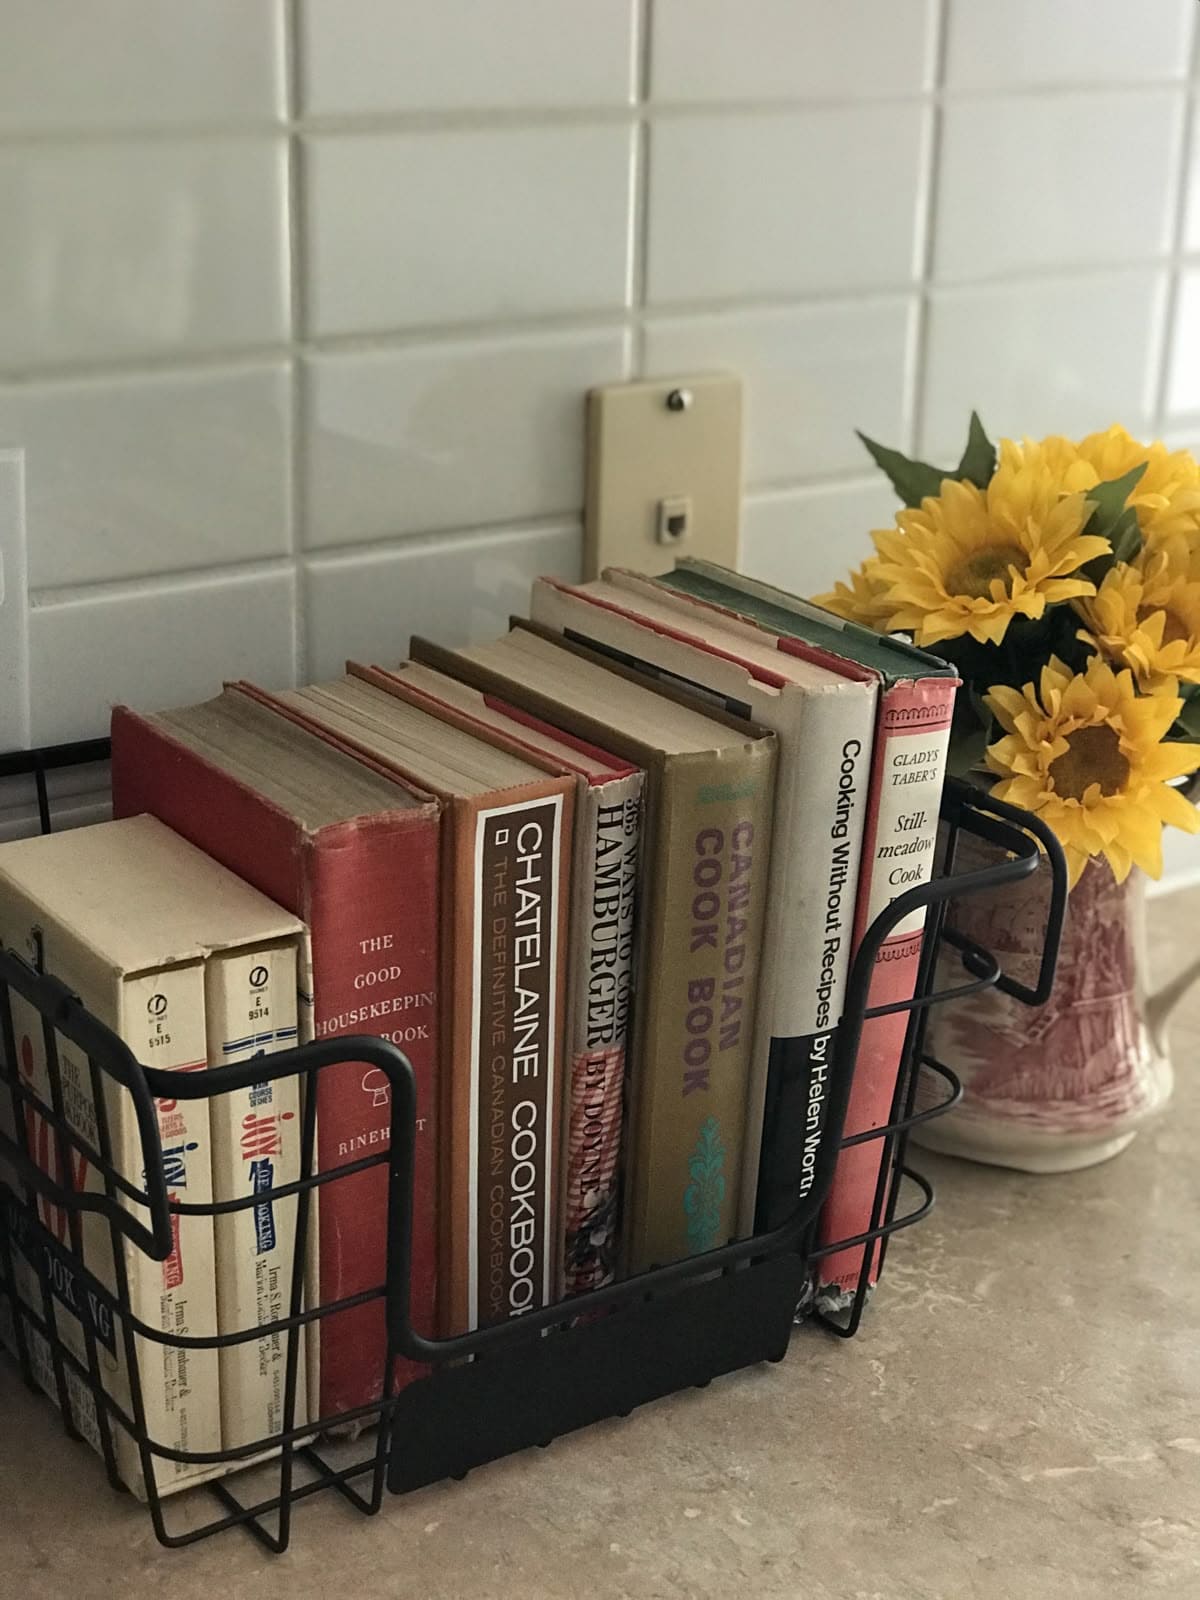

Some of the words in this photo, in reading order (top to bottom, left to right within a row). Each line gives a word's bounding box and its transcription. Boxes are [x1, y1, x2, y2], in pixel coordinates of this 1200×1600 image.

[891, 767, 938, 786] TABER'S
[893, 749, 940, 767] GLADYS
[831, 739, 861, 839] Cooking
[894, 811, 928, 832] Still-
[877, 837, 934, 859] meadow
[493, 856, 508, 906] THE
[621, 843, 637, 920] WAYS
[690, 827, 724, 952] COOK
[825, 841, 850, 933] Without
[889, 863, 924, 886] Cook
[359, 934, 393, 955] THE
[587, 801, 624, 1048] HAMBURGER
[719, 820, 754, 1051] CANADIAN
[512, 822, 543, 1083] CHATELAINE
[354, 966, 401, 989] GOOD
[492, 918, 506, 1046] DEFINITIVE
[816, 937, 841, 1028] Recipes
[248, 1007, 269, 1021] 9514
[255, 996, 261, 1007] E
[316, 991, 436, 1037] HOUSEKEEPIN
[615, 970, 630, 1041] COOK
[156, 1023, 162, 1033] E
[682, 977, 716, 1098] BOOK
[809, 1034, 831, 1062] by
[585, 1059, 606, 1091] BY
[806, 1064, 828, 1131] Helen
[338, 1118, 427, 1155] RINEHT
[490, 1056, 506, 1176] CANADIAN
[257, 1201, 273, 1250] OKING
[268, 1266, 281, 1291] Irma
[175, 1300, 187, 1326] Irma
